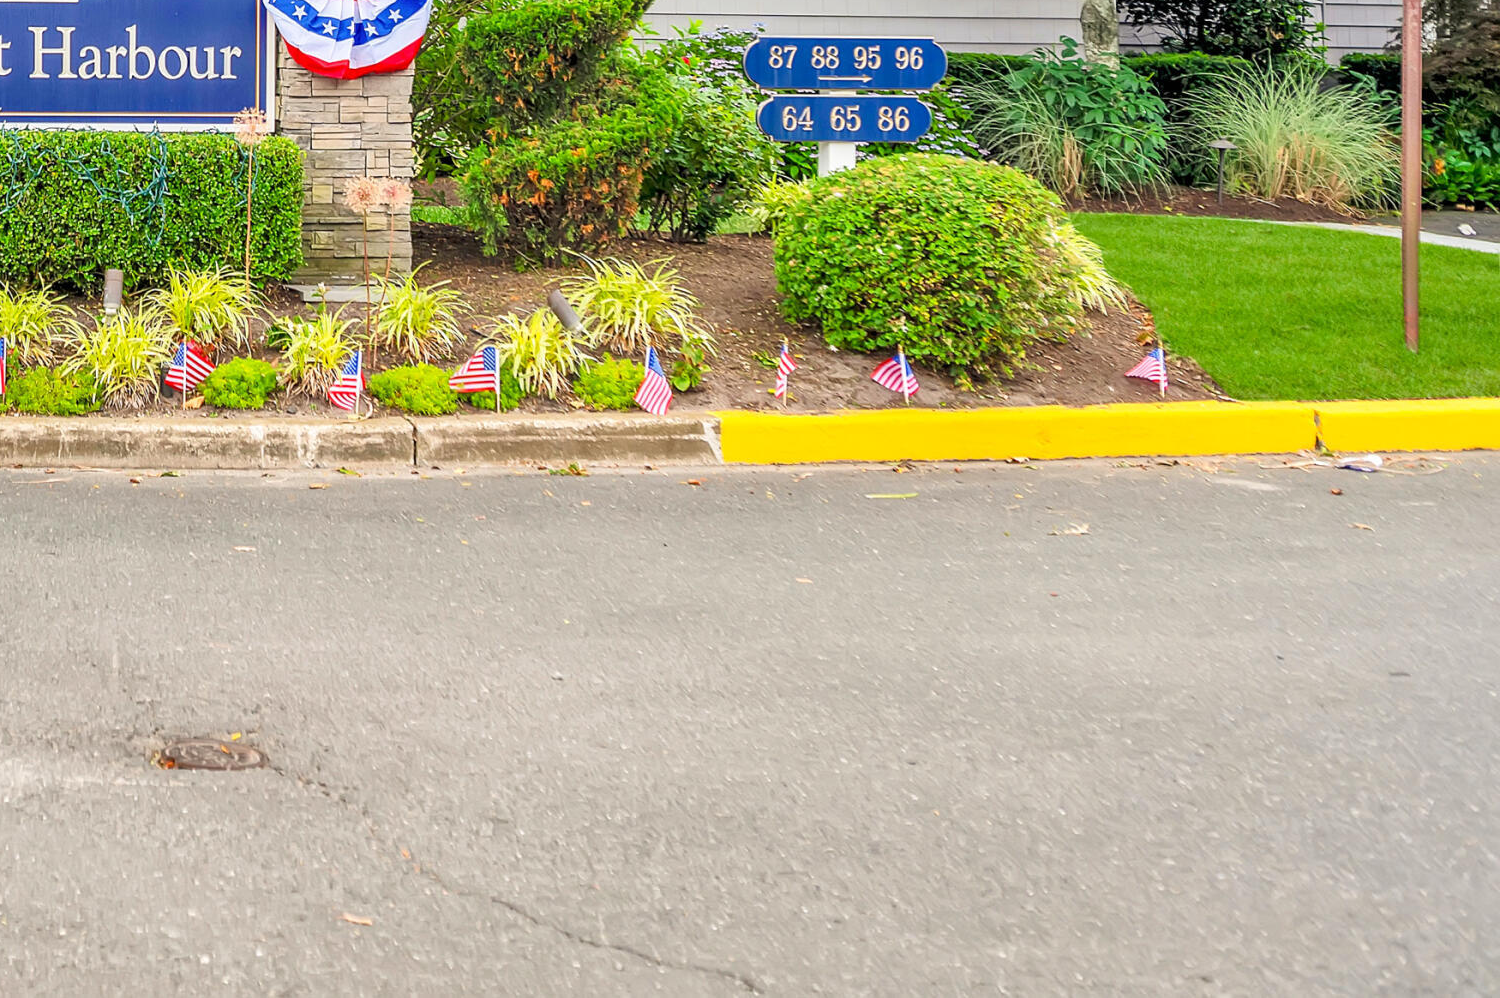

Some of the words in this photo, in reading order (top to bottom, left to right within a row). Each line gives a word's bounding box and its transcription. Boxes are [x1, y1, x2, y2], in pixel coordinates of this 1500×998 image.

[27, 24, 242, 80] Harbour
[768, 45, 798, 69] 87
[811, 45, 840, 69] 88
[853, 45, 882, 70] 95
[895, 46, 924, 70] 96
[782, 106, 814, 131] 64
[830, 104, 862, 132] 65
[877, 106, 910, 132] 86
